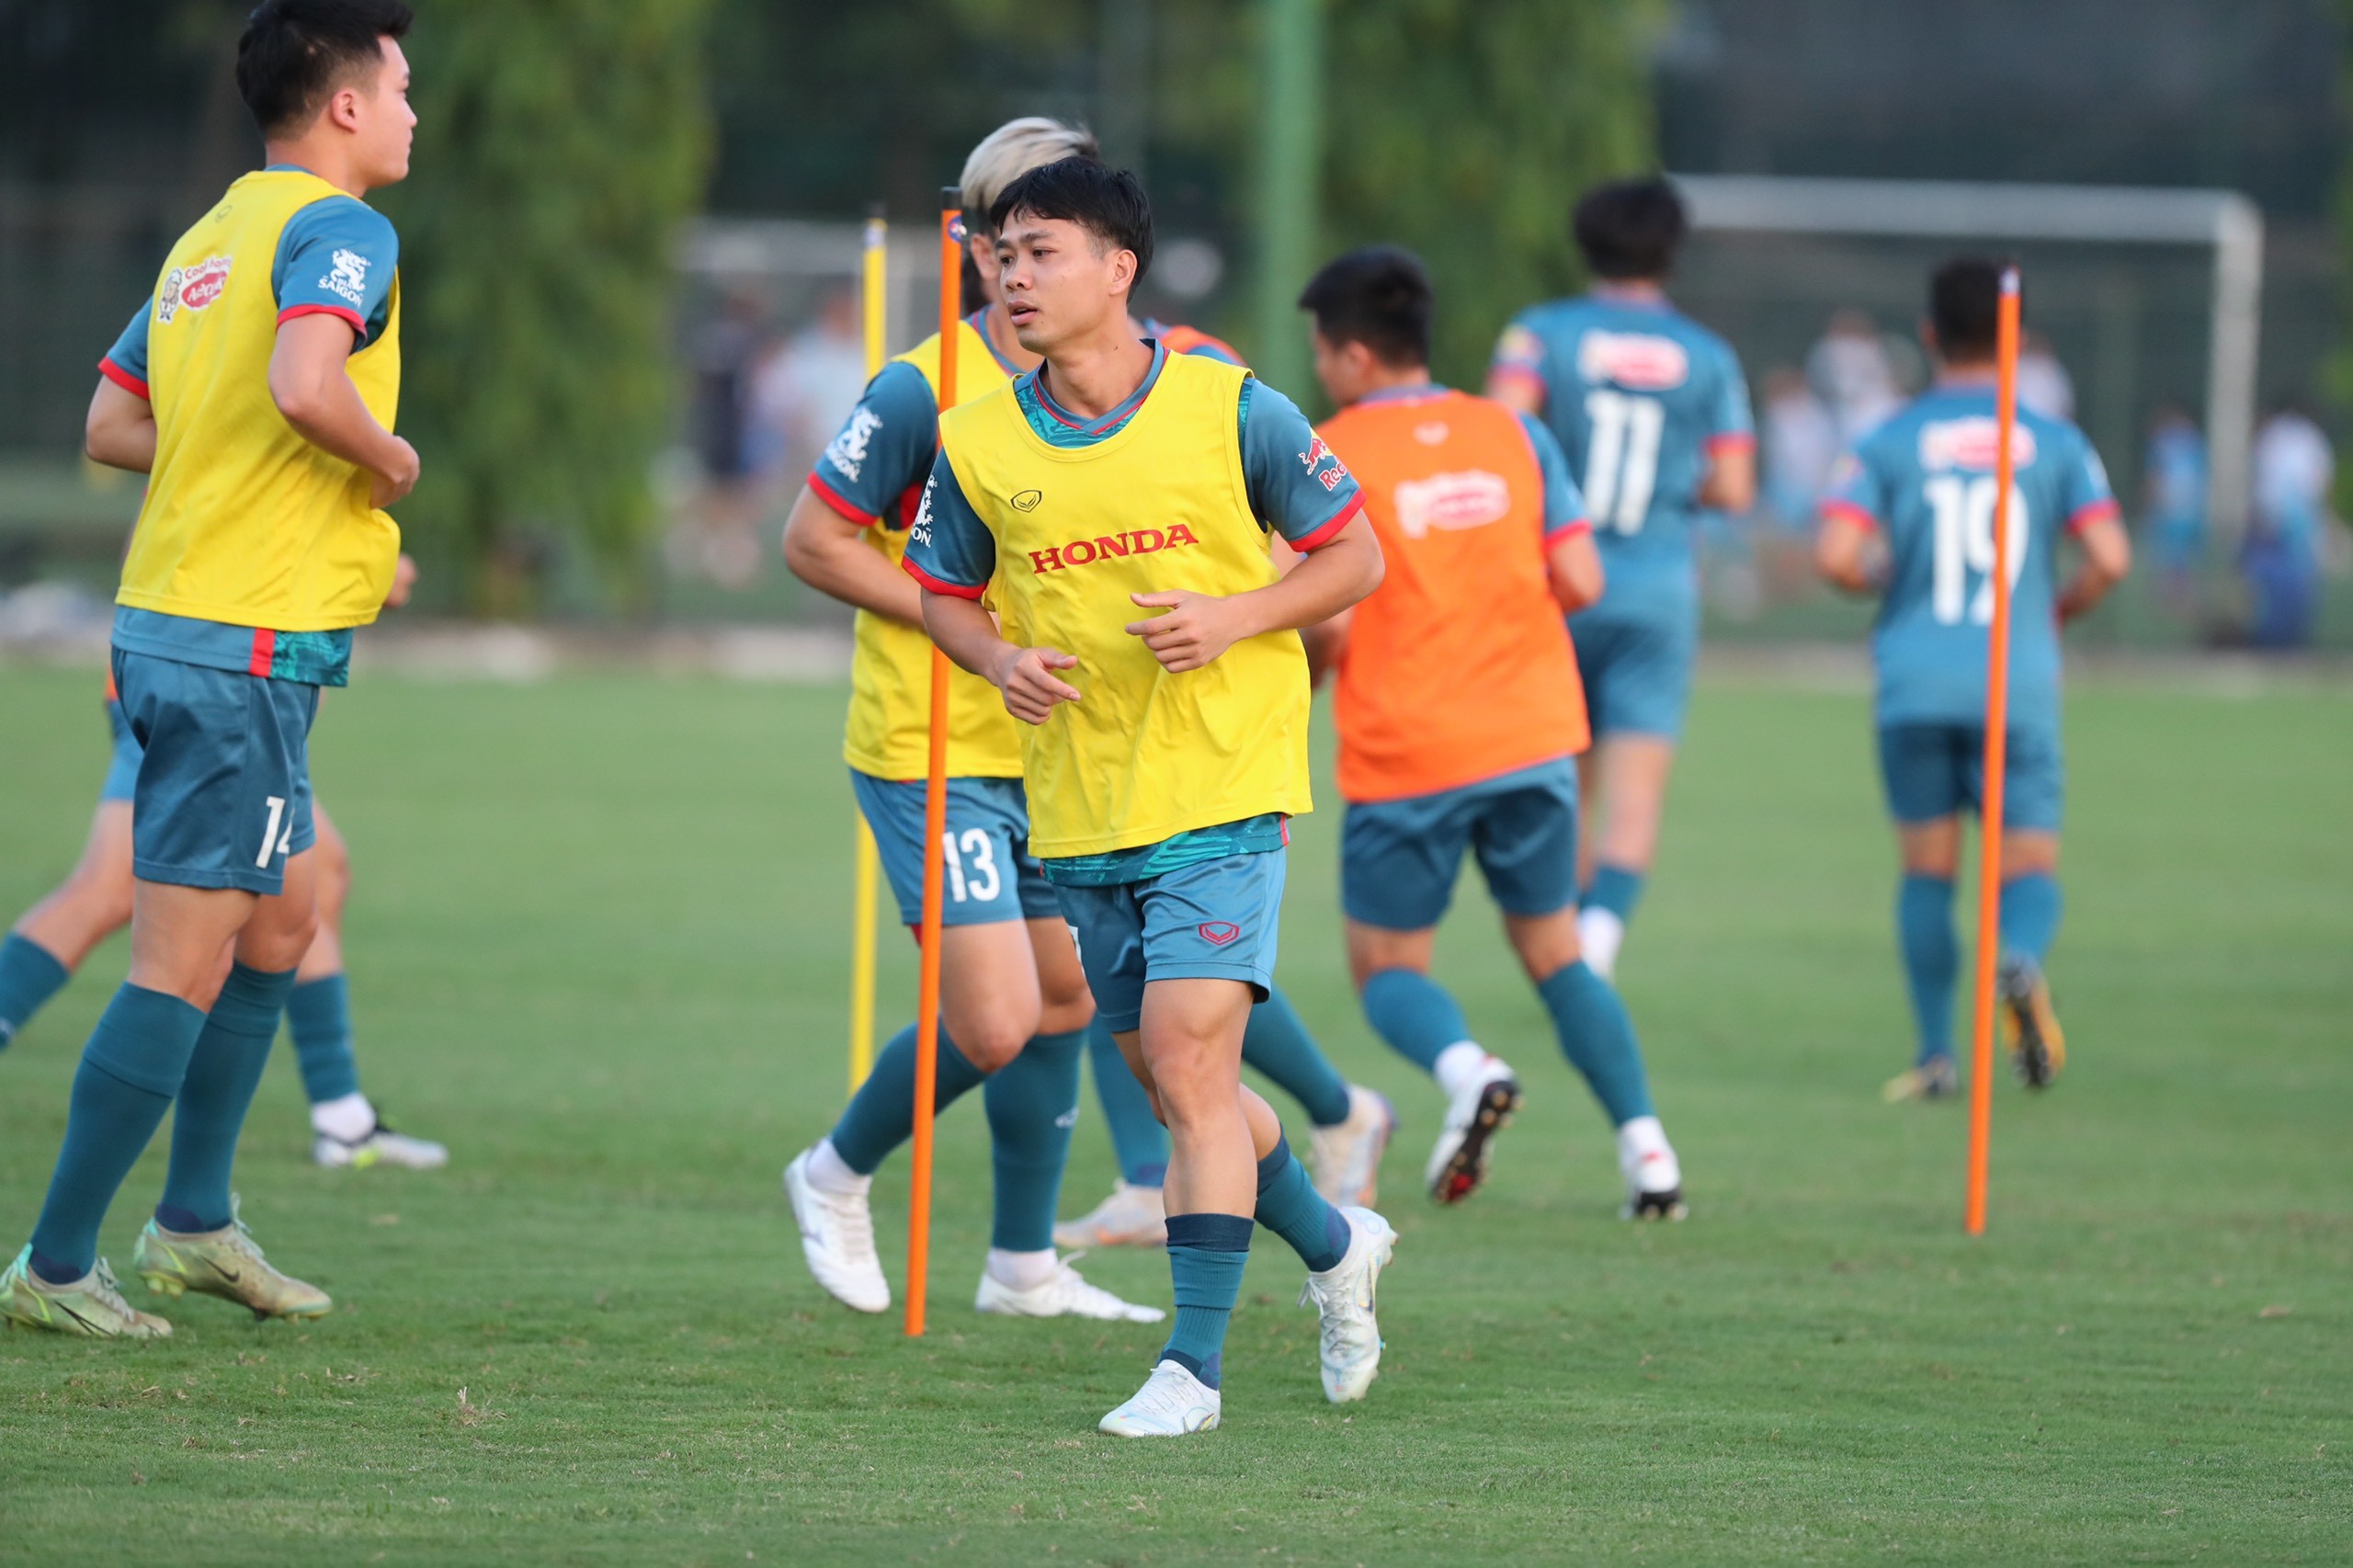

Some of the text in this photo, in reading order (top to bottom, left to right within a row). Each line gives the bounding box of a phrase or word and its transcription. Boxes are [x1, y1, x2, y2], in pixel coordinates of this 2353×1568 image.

[317, 278, 363, 308] SAIGON
[1584, 389, 1665, 537] 11
[1028, 523, 1199, 574] HONDA
[1922, 474, 2030, 626] 19
[941, 827, 1001, 903] 13
